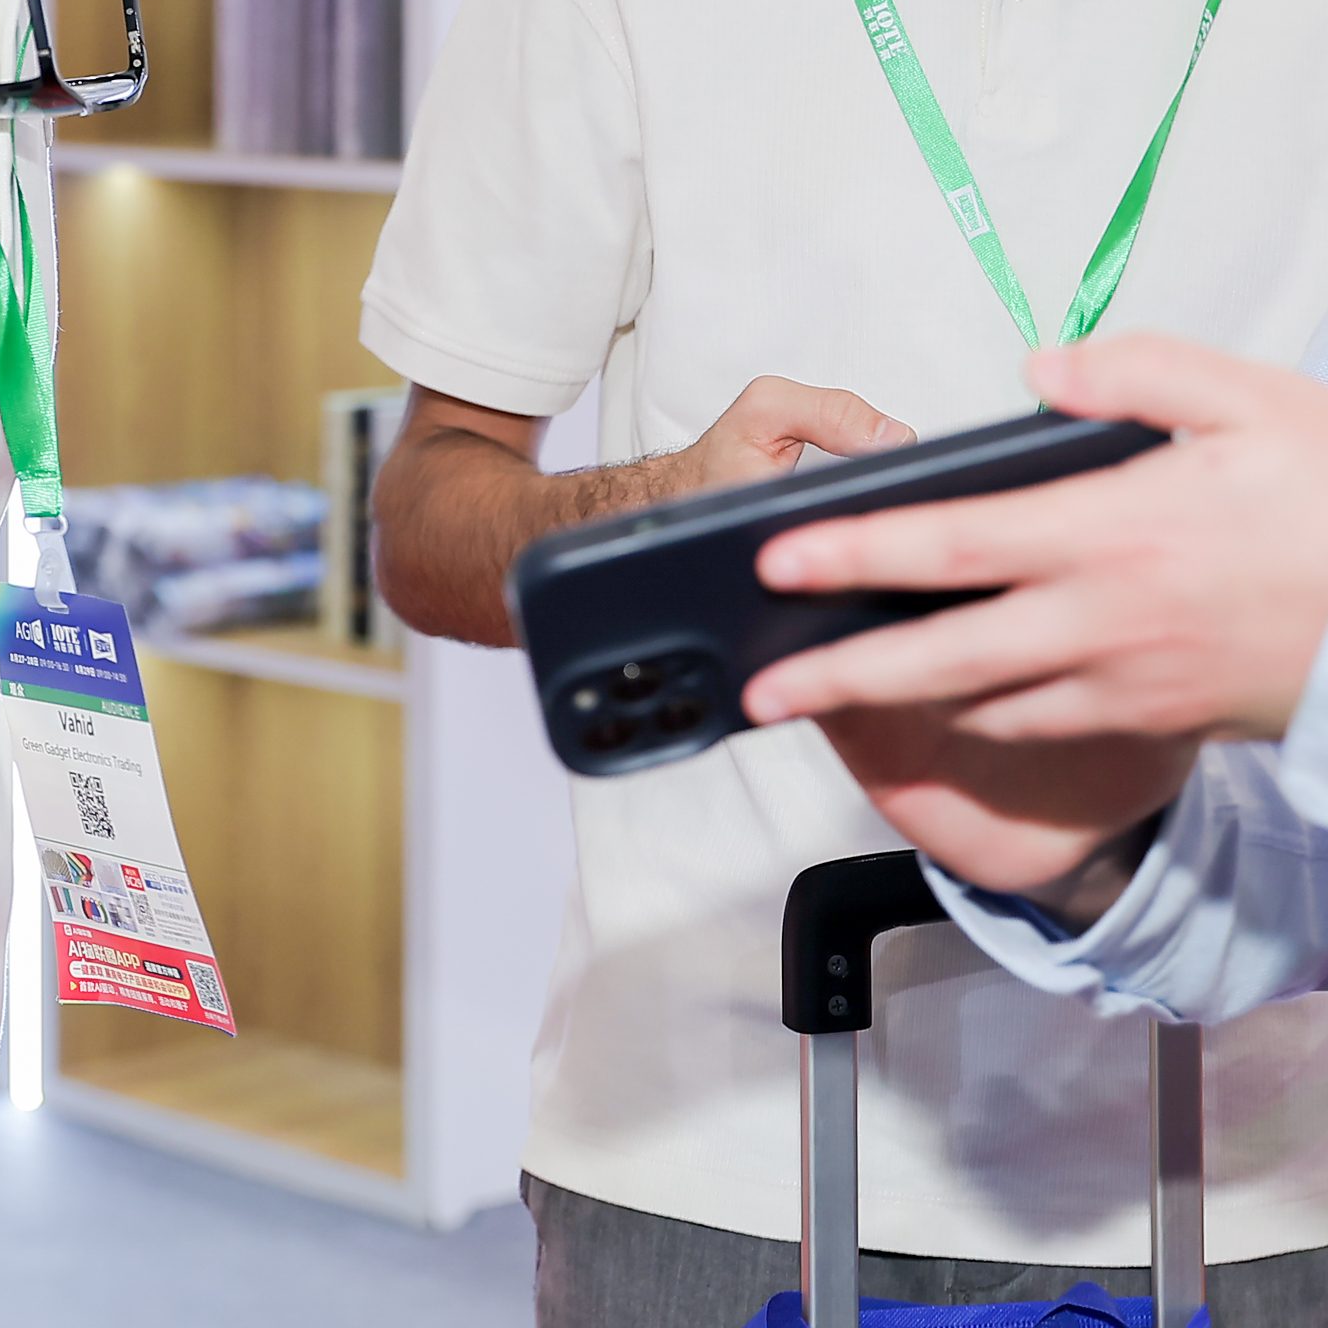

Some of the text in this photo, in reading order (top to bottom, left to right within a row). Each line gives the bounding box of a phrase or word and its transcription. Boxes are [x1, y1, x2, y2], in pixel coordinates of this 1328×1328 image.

[15, 619, 45, 649] AGIC
[58, 710, 95, 736] Vahid
[101, 701, 141, 719] AUDIENCE
[22, 737, 143, 777] Green Gadget Electronics Trading
